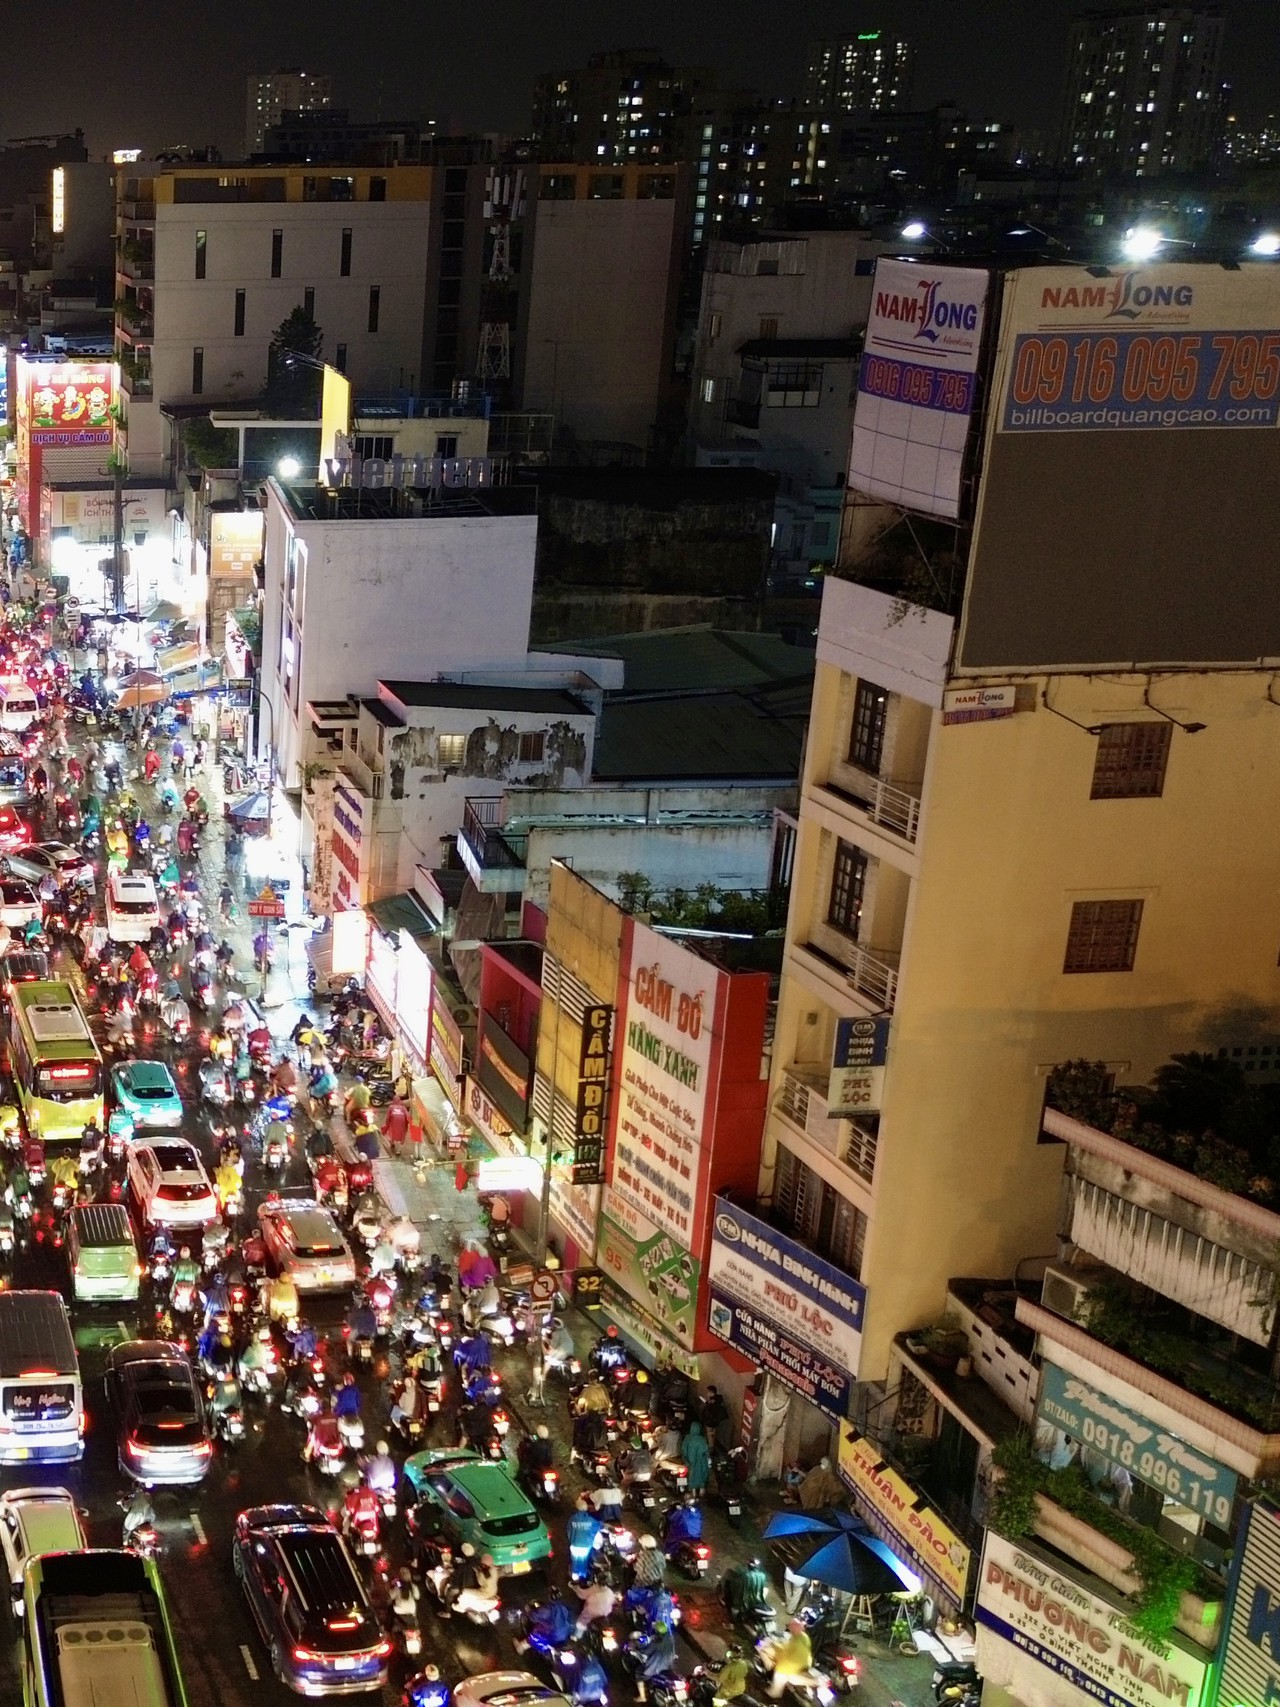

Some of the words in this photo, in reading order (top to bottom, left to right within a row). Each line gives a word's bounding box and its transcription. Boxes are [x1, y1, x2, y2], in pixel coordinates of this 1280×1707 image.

[875, 292, 918, 323] NAM
[1041, 286, 1106, 308] NAM
[865, 358, 901, 397] 0916
[901, 366, 934, 404] 095
[934, 372, 969, 411] 795
[1014, 337, 1118, 404] 0916
[1122, 336, 1201, 401] 095
[1208, 335, 1280, 400] 795
[1011, 407, 1270, 426] billboardquangcao.com
[741, 1228, 782, 1266] NHỰA
[735, 1308, 752, 1324] CỬA
[753, 1317, 777, 1342] HÀNG
[764, 1279, 799, 1311] PHÚ
[801, 1303, 832, 1336] LỘC
[739, 1324, 756, 1343] NHÀ
[757, 1336, 780, 1359] PHÂN
[781, 1348, 800, 1371] PHỐI
[802, 1363, 820, 1384] MÁY
[759, 1348, 816, 1395] Panasonic
[1083, 1414, 1229, 1523] 0918.996.119
[852, 1451, 905, 1511] THUẬN
[908, 1511, 947, 1555] ĐÀO
[984, 1559, 1111, 1655] PHƯƠNG
[1117, 1643, 1193, 1704] NAM
